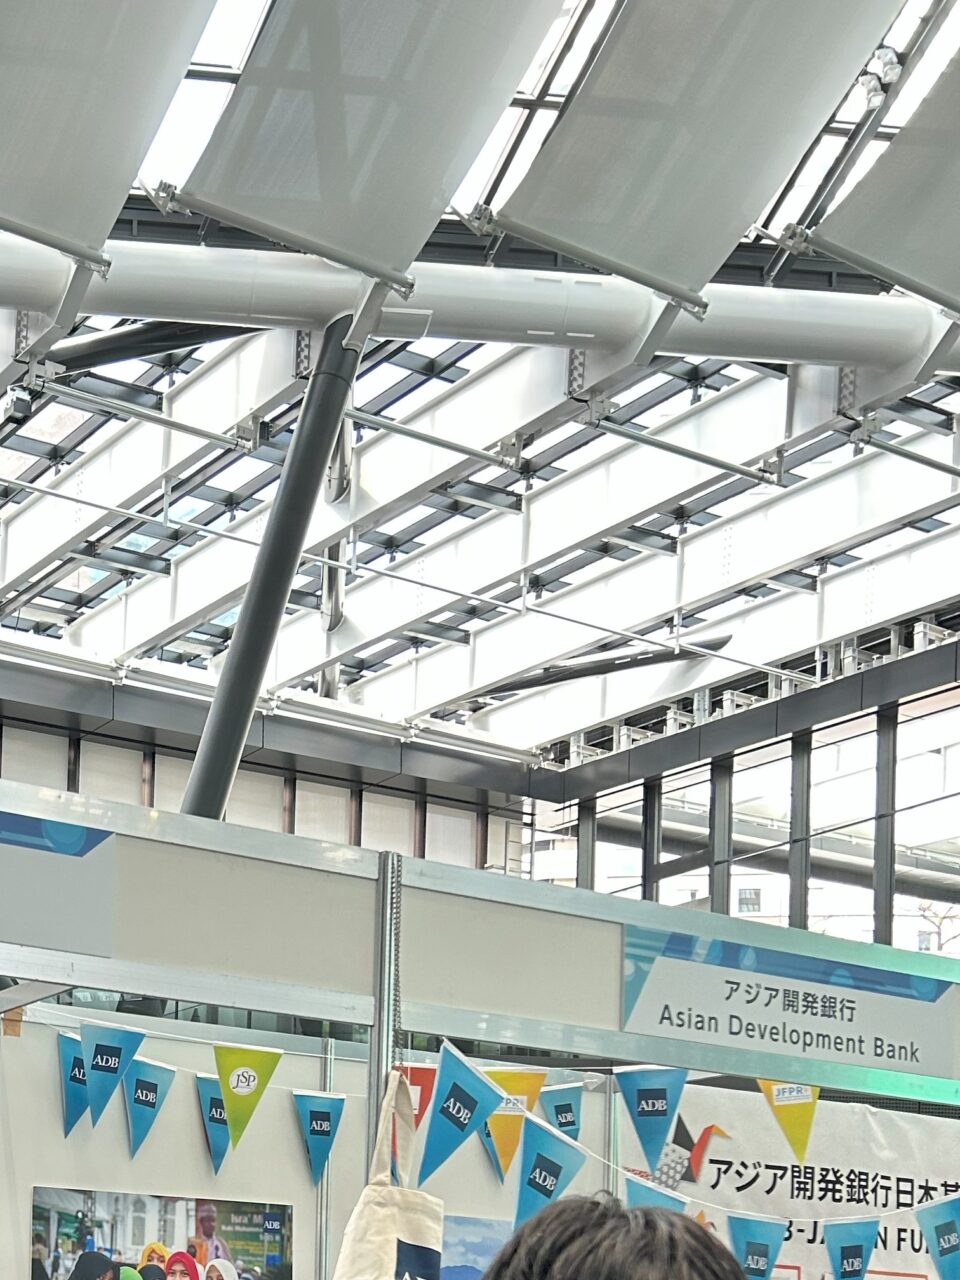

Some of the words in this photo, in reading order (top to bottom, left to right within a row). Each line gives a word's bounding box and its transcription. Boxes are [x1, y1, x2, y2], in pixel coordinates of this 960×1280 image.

[725, 980, 856, 1023] アジア開発銀行
[659, 1004, 718, 1033] Asian
[729, 1015, 865, 1055] Development
[875, 1037, 920, 1063] Bank
[93, 1052, 119, 1069] ADB
[134, 1087, 158, 1103] ADB
[775, 1086, 804, 1097] JFPR
[443, 1098, 471, 1125] ADB
[638, 1099, 667, 1113] ADB
[310, 1118, 331, 1132] ADB
[557, 1113, 574, 1123] ADB
[530, 1168, 557, 1190] ADB
[264, 1220, 280, 1230] ADB
[939, 1233, 959, 1250] ADB
[745, 1255, 768, 1270] ADB
[841, 1257, 862, 1271] ADB
